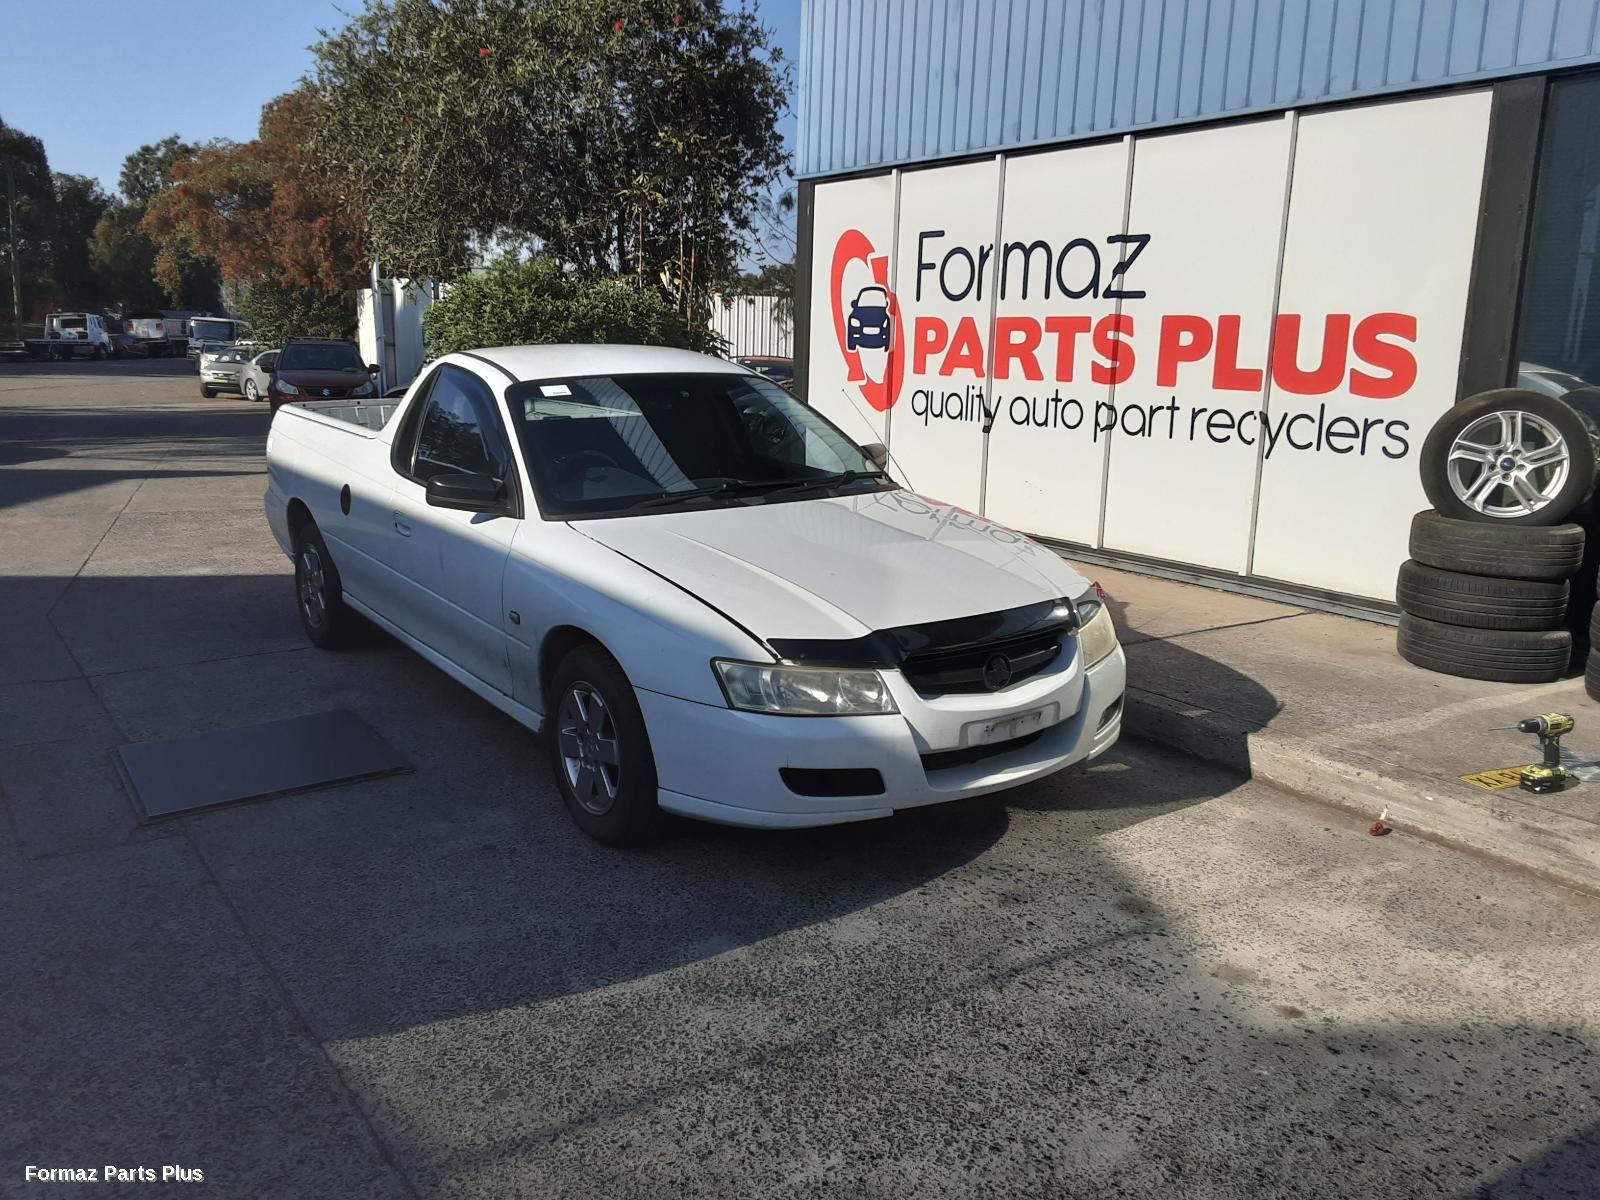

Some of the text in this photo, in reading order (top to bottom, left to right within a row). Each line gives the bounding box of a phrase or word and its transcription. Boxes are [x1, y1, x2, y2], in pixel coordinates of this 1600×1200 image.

[916, 230, 1151, 302] Formaz
[913, 312, 1418, 399] PARTS PLUS
[911, 384, 1410, 460] quality auto part recyclers
